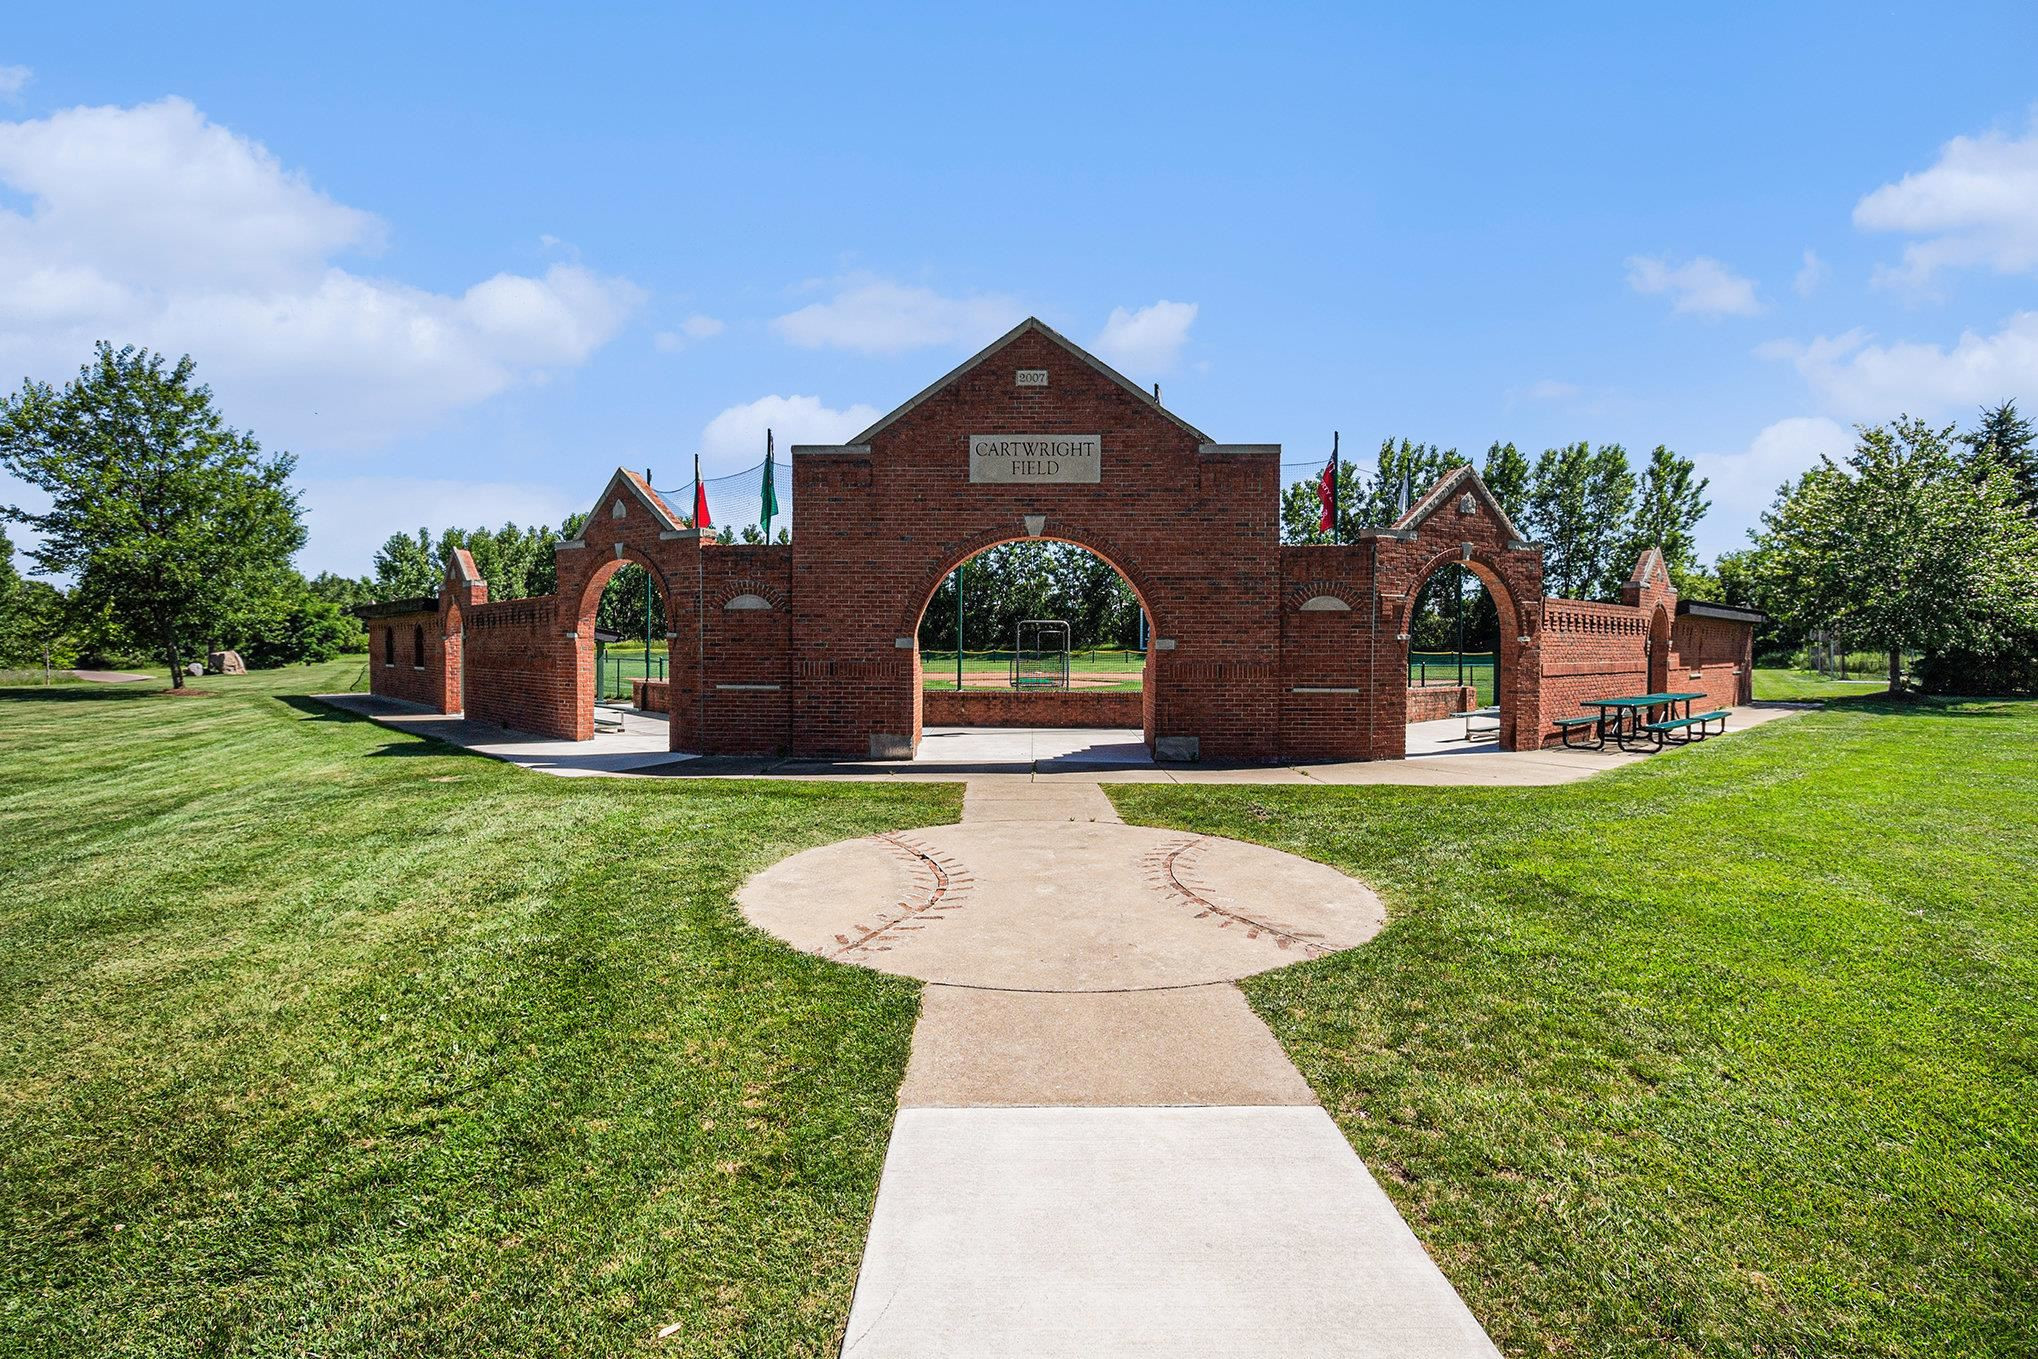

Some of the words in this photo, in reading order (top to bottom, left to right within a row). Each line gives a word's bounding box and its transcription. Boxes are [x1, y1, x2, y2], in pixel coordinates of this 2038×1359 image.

[1019, 373, 1046, 383] 2007
[975, 442, 1095, 457] CARTWRIGHT
[1012, 460, 1060, 475] FIELD
